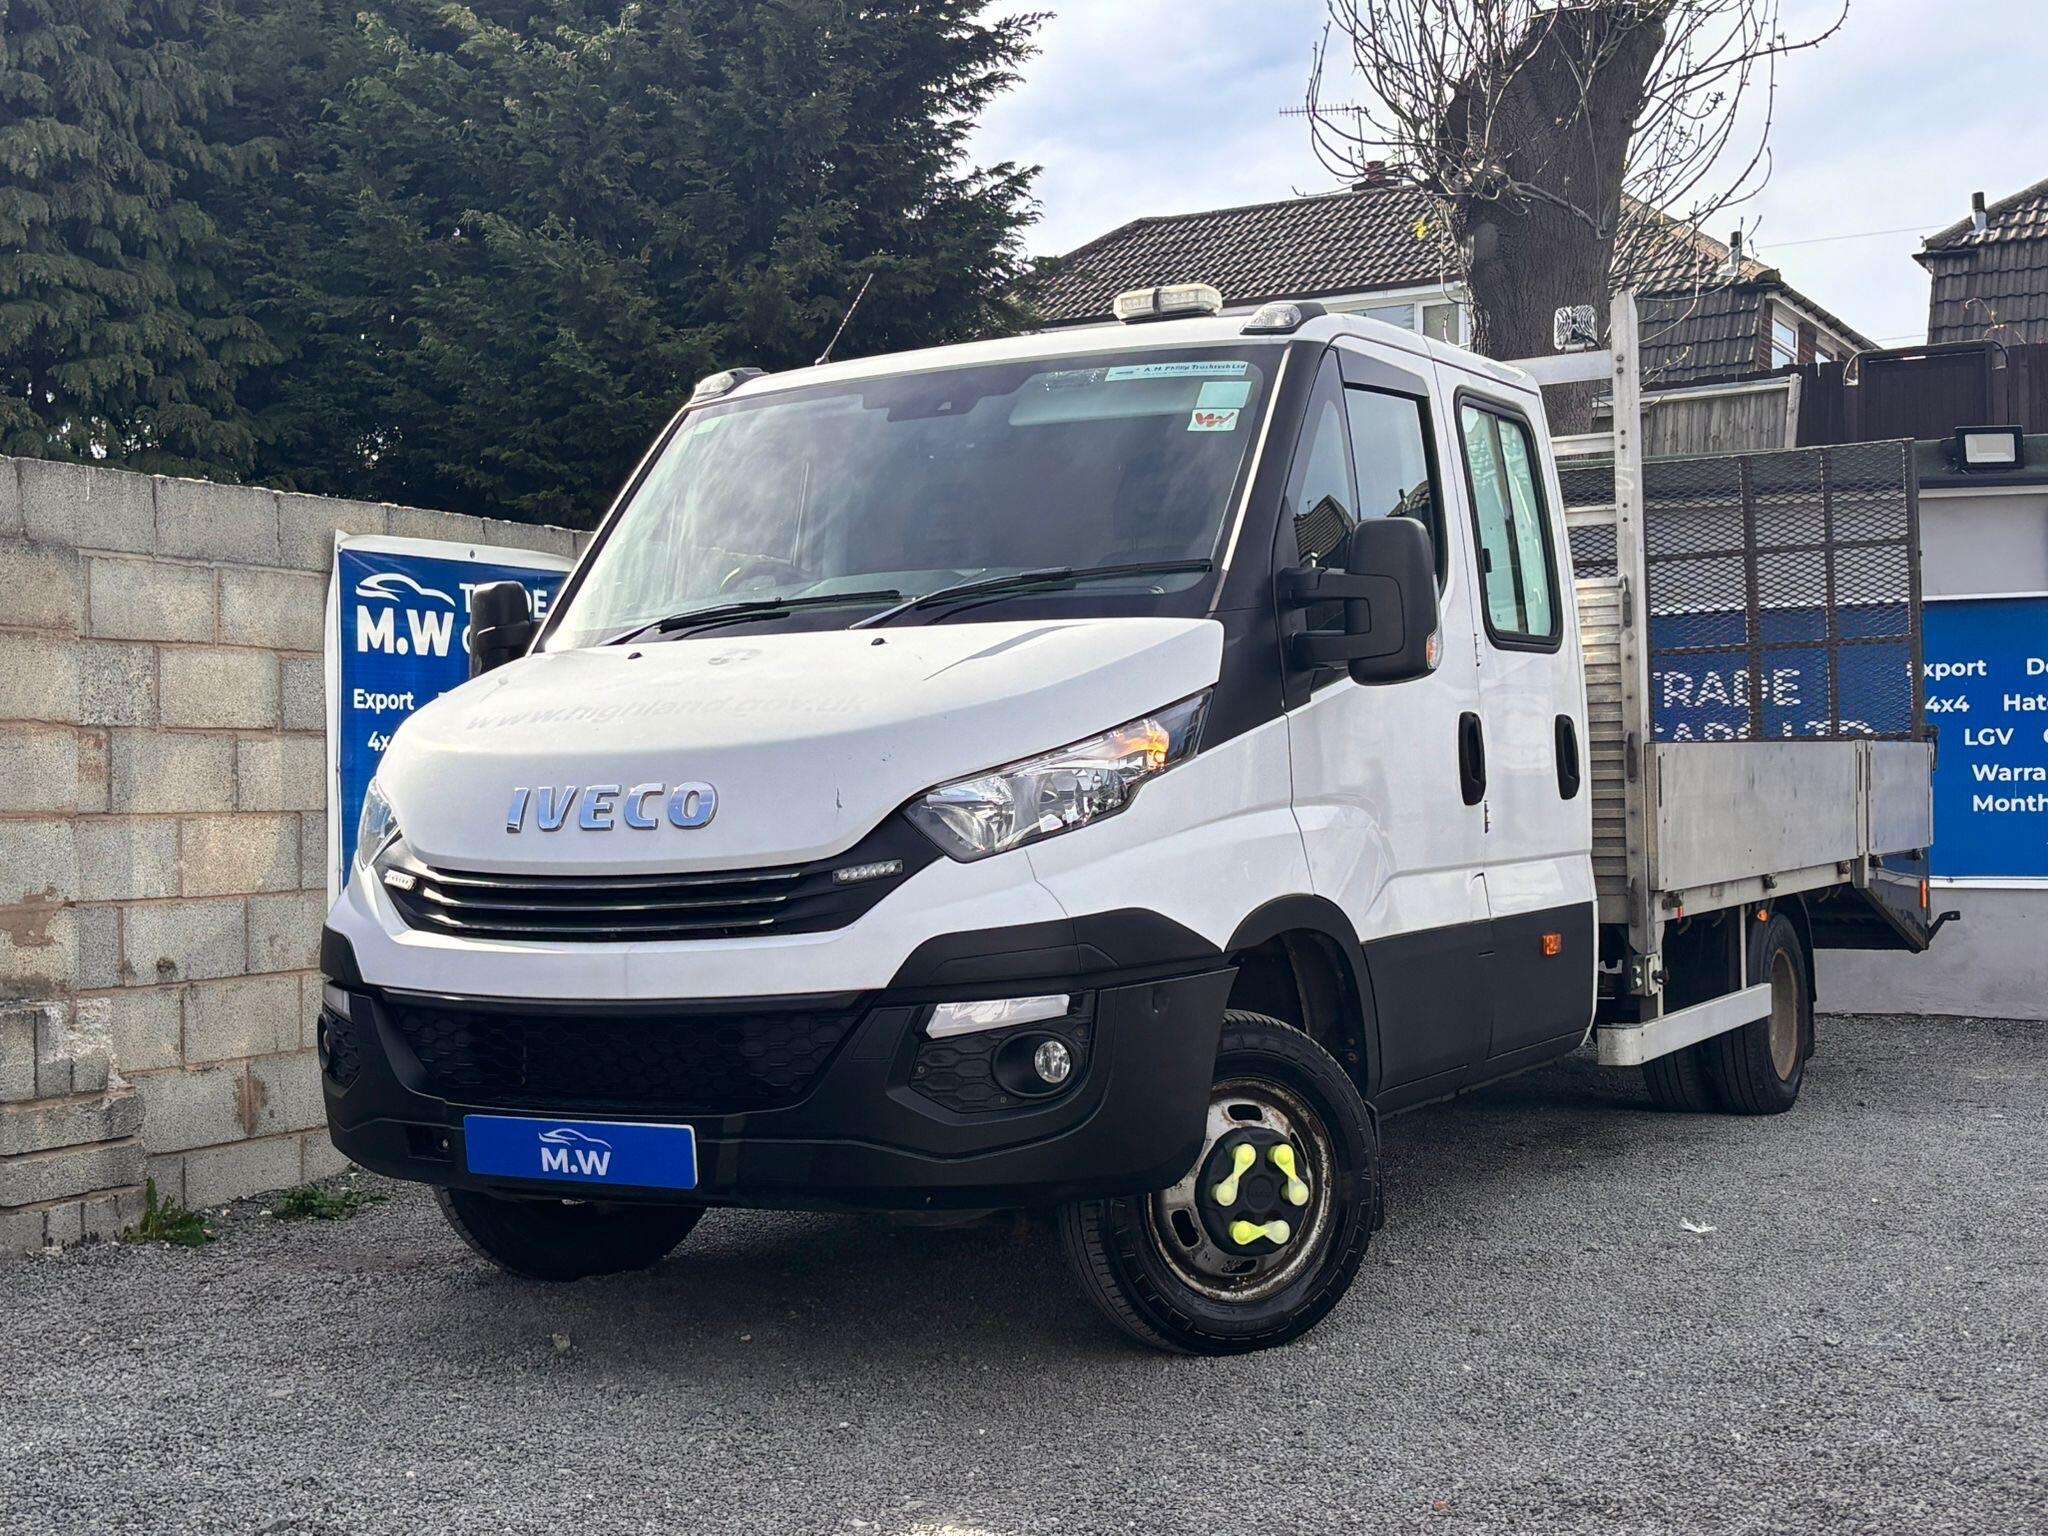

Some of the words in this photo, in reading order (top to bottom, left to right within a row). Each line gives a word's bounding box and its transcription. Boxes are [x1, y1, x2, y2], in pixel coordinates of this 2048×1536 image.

[357, 605, 454, 657] M.W
[1923, 659, 1988, 682] xport
[353, 688, 415, 715] Export
[1653, 669, 1801, 707] RADE
[1924, 695, 1970, 713] 4x4
[2003, 693, 2048, 712] Hat
[1964, 728, 2014, 746] LGV
[506, 781, 719, 834] IVECO
[540, 1147, 611, 1176] M.W
